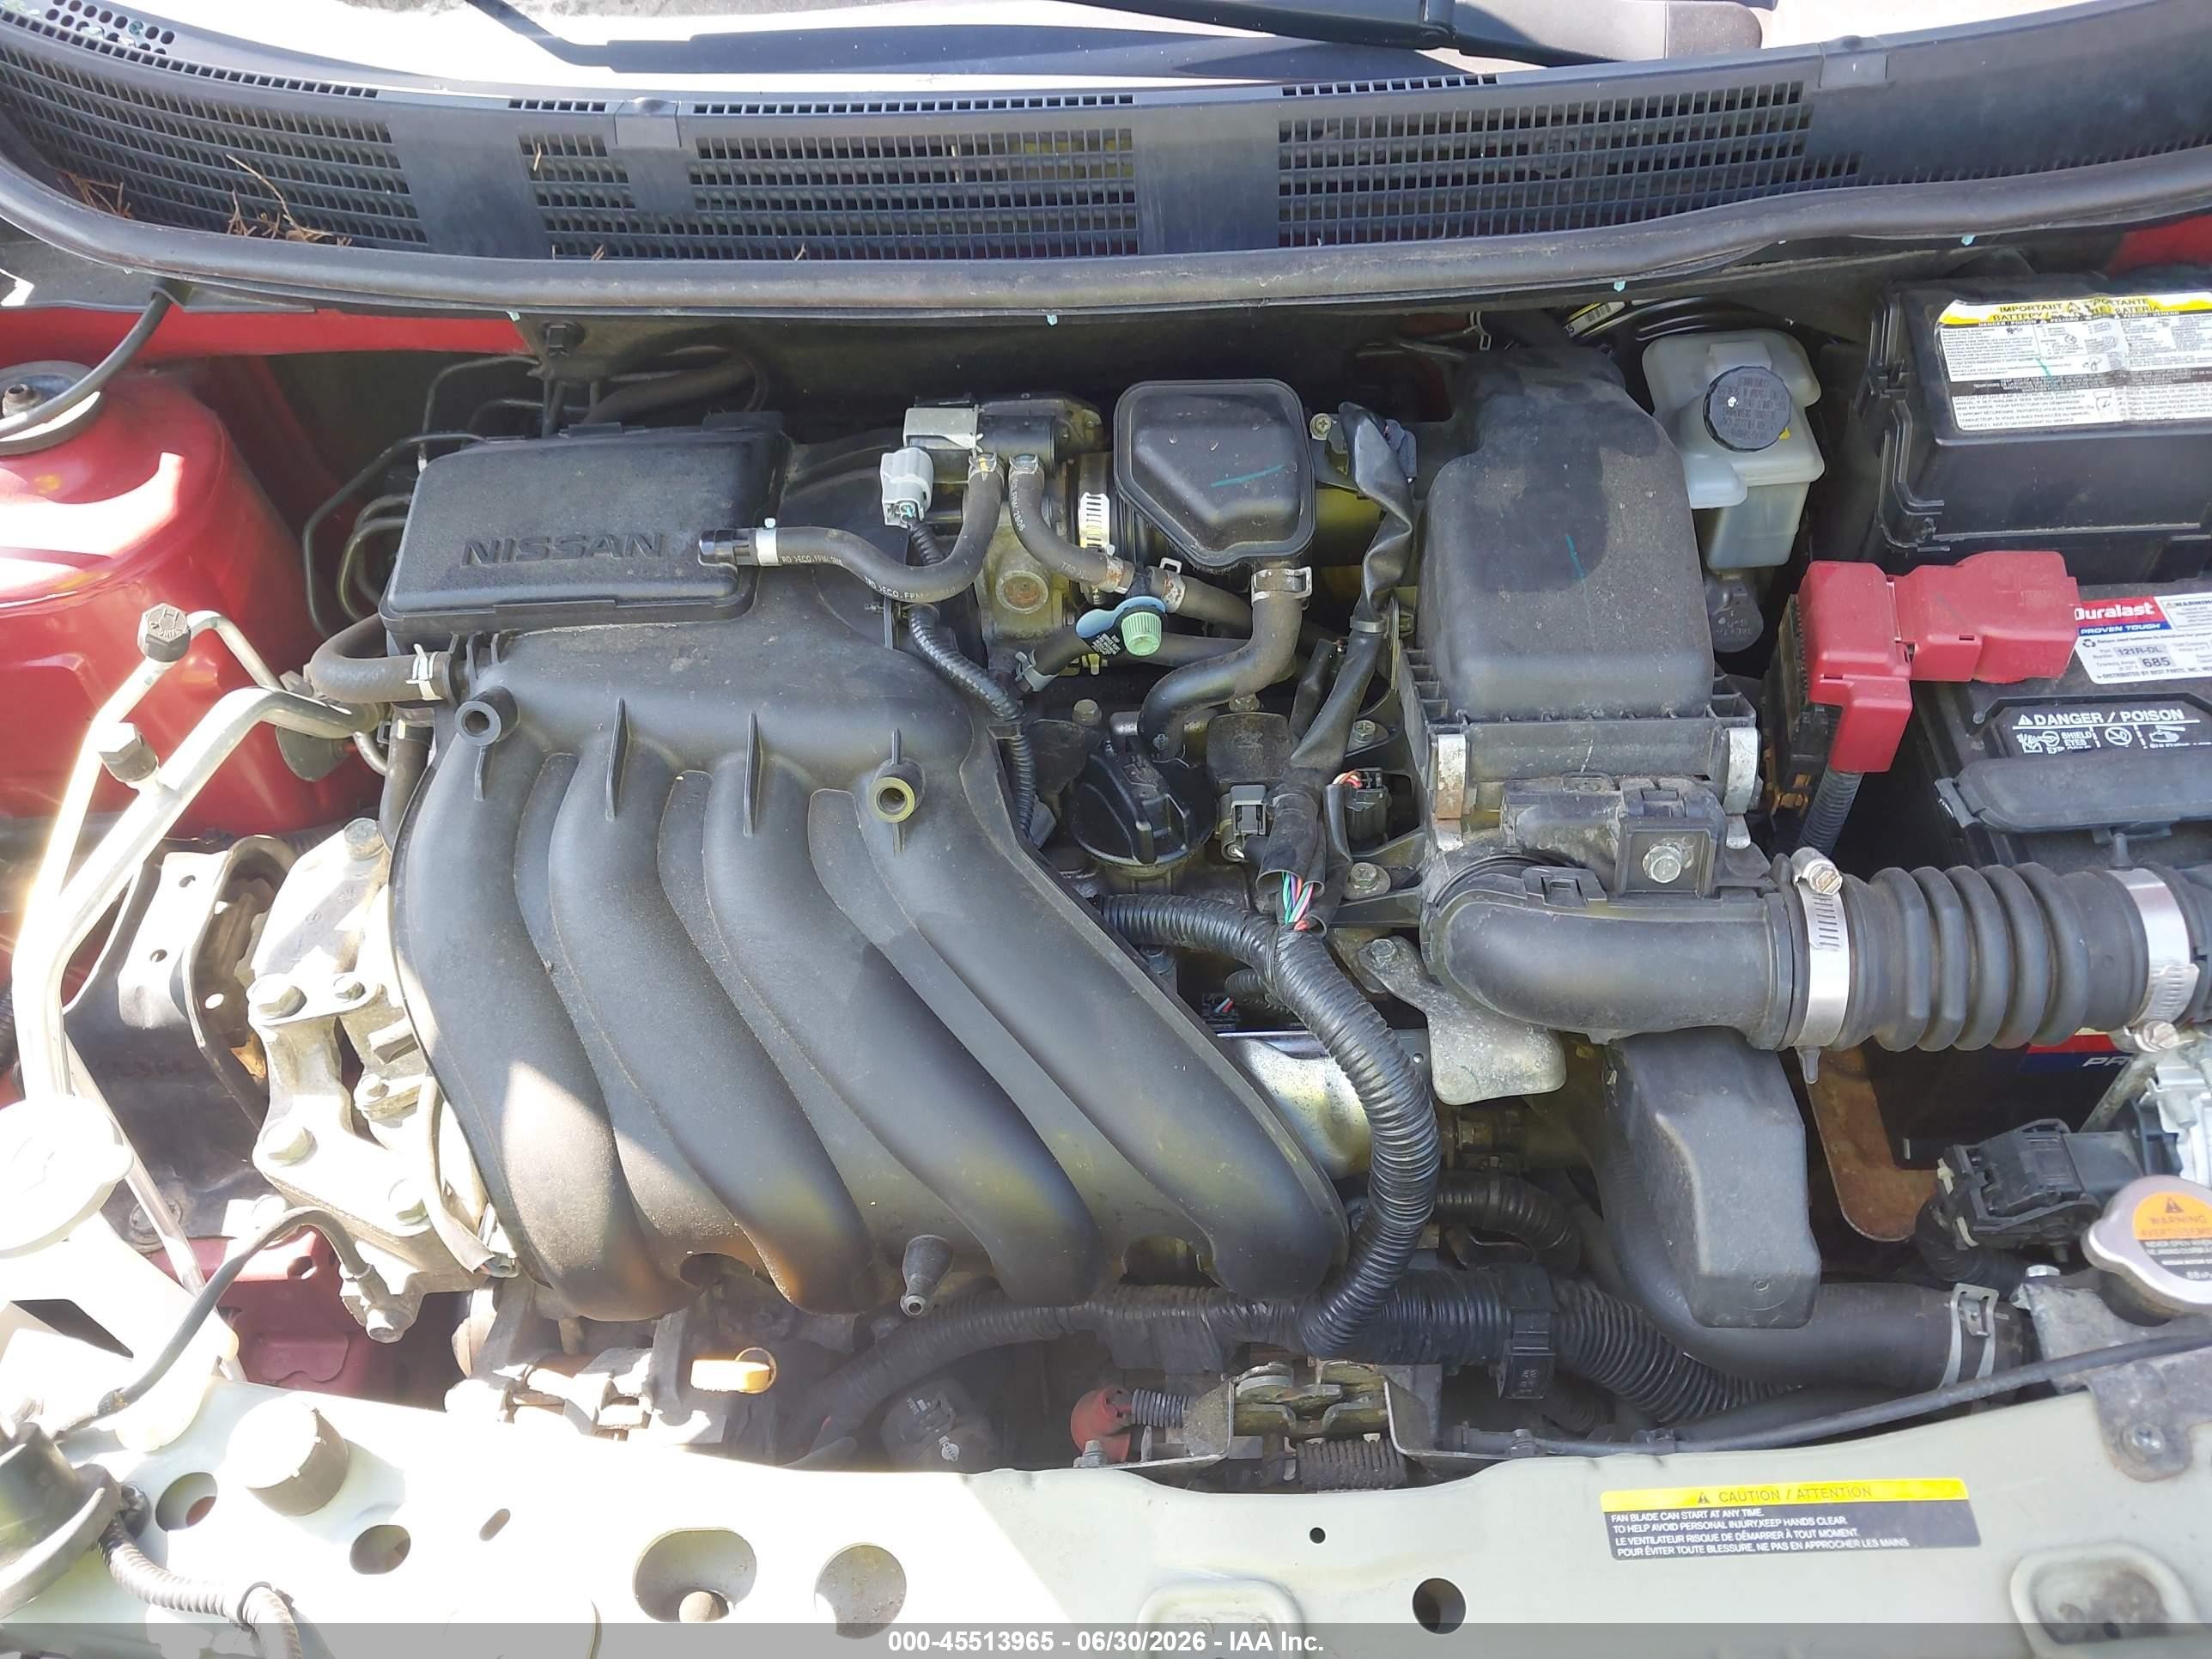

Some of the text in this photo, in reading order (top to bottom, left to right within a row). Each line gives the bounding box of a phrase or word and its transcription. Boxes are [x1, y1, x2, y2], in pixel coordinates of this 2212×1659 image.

[1992, 312, 2042, 321] BATTERY
[460, 532, 664, 567] NISSAN
[2075, 602, 2155, 621] Duralast
[2081, 623, 2160, 635] PROVEN TOUGH
[2118, 646, 2163, 657] 121R-DL
[2142, 657, 2171, 668] 685
[2034, 713, 2104, 726] DANGER
[2120, 709, 2185, 722] POISON
[2061, 731, 2093, 739] SHIELD
[1718, 1489, 1781, 1503] CAUTION
[1796, 1486, 1873, 1499] ATTENTION
[1611, 1513, 1628, 1522] FAN
[1631, 1512, 1659, 1522] BLADE
[1660, 1511, 1680, 1521] CAN
[1681, 1510, 1708, 1520] START
[1710, 1510, 1721, 1519] AT
[1723, 1509, 1741, 1518] ANY
[1613, 1524, 1626, 1534] TO
[1627, 1523, 1650, 1533] HELP
[1651, 1522, 1678, 1532] AVOID
[1680, 1521, 1727, 1531] PERSONAL
[1783, 1517, 1815, 1527] HANDS
[1615, 1537, 1627, 1547] LE
[1628, 1535, 1685, 1546] VENTILATEUR
[1686, 1534, 1720, 1544] RISQUE
[1721, 1533, 1735, 1541] DE
[1735, 1529, 1784, 1541] DÉMARRER
[1793, 1529, 1817, 1539] TOUT
[1618, 1548, 1644, 1558] POUR
[1644, 1546, 1675, 1556] ÉVITER
[1677, 1545, 1705, 1554] TOUTE
[1756, 1542, 1770, 1552] NE
[1771, 1541, 1789, 1551] PAS
[1790, 1540, 1803, 1551] EN
[1804, 1539, 1861, 1550] APPROCHER
[1862, 1538, 1879, 1547] LES
